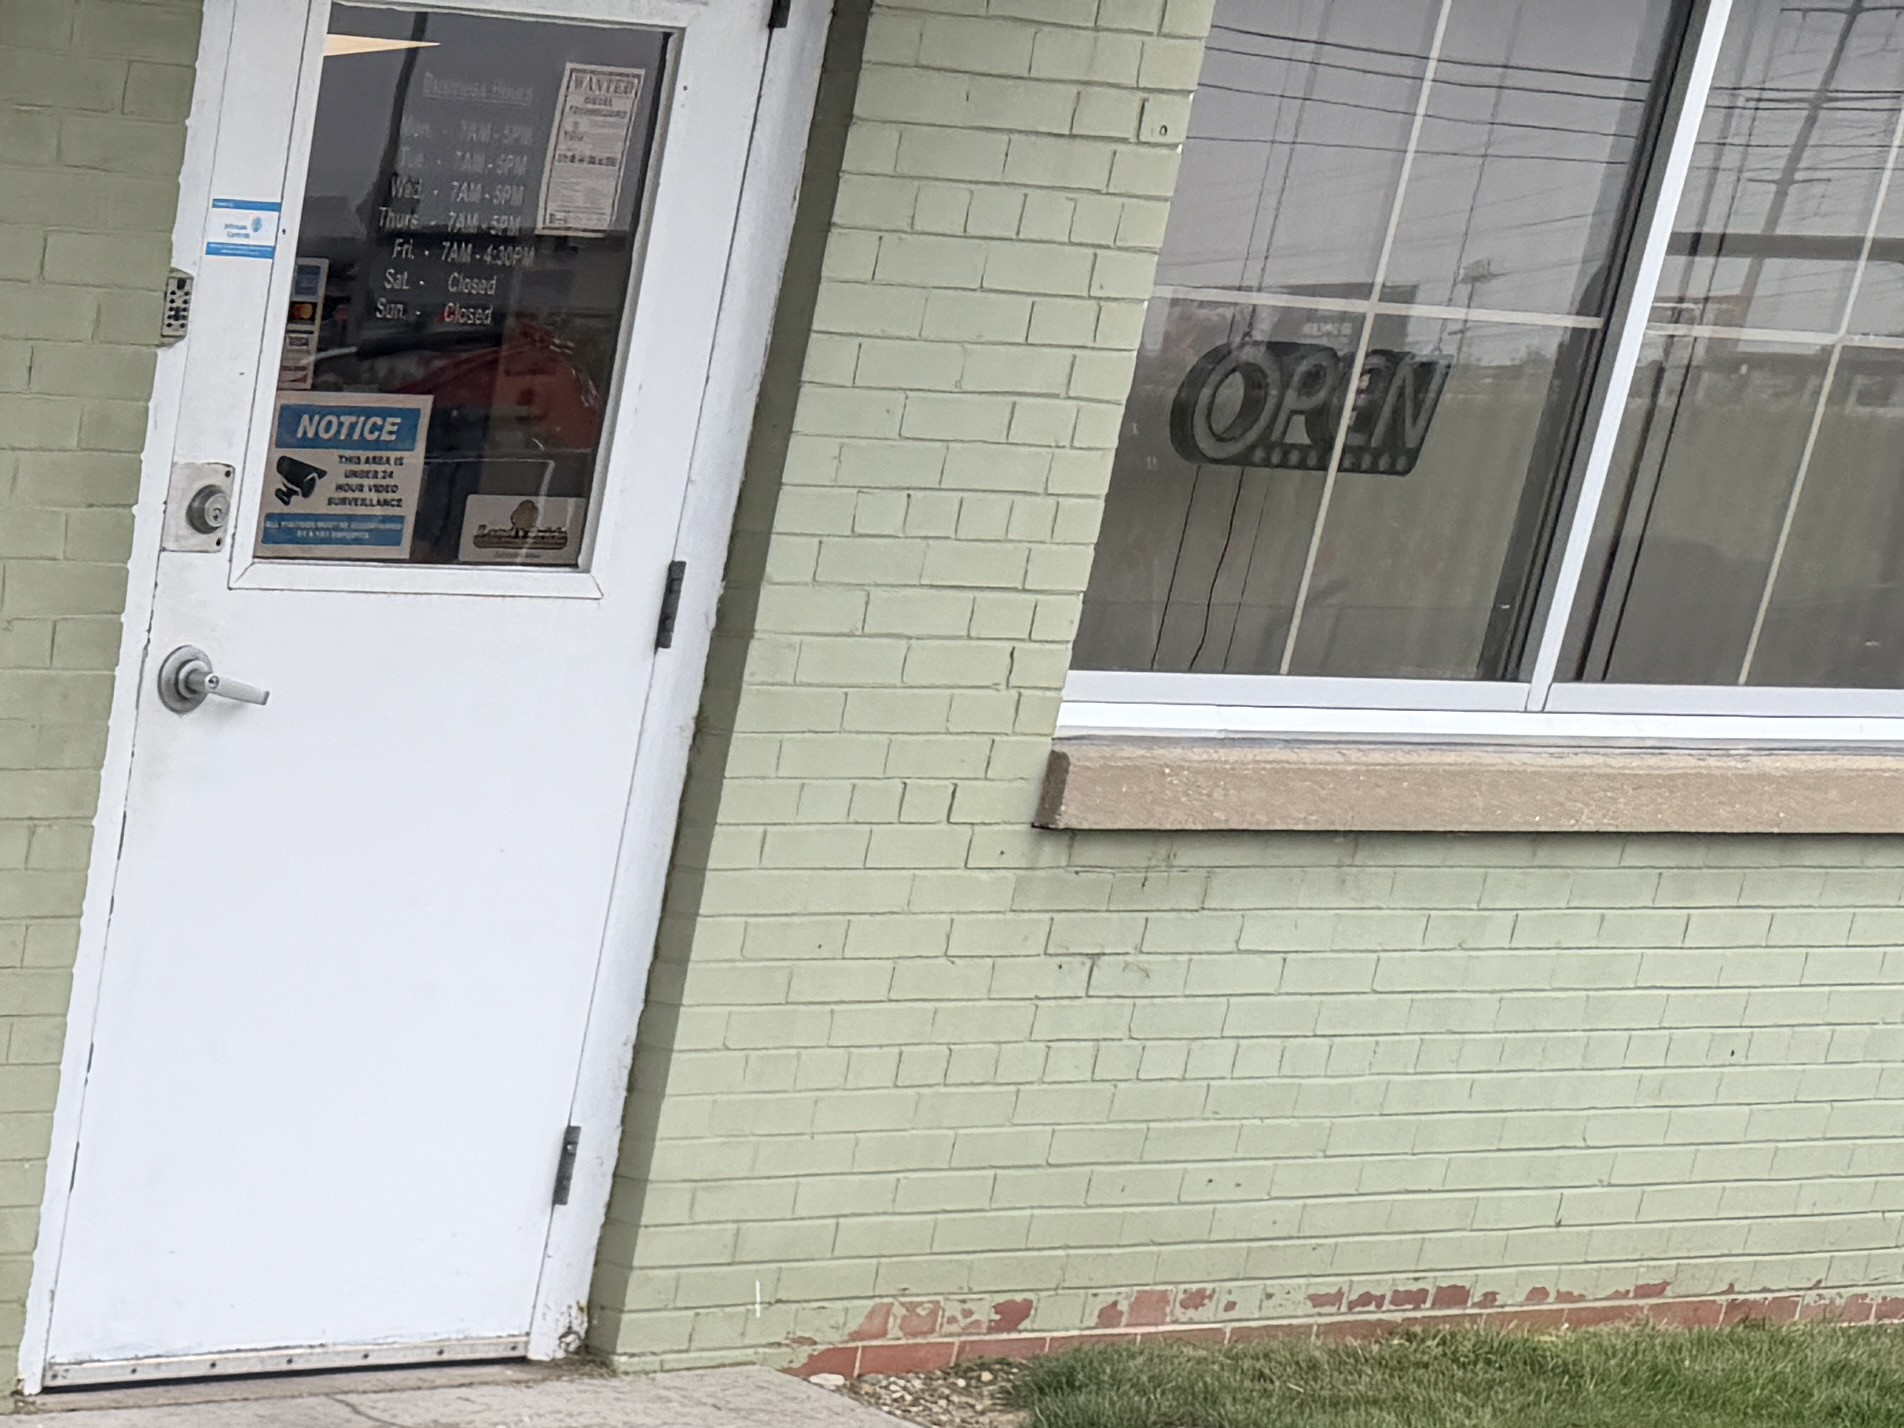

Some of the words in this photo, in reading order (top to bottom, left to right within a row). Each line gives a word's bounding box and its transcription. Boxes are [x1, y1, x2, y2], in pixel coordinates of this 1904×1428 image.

[447, 271, 498, 295] Closed
[444, 302, 494, 325] Closed
[1193, 347, 1454, 461] OPEN
[296, 413, 402, 442] NOTICE
